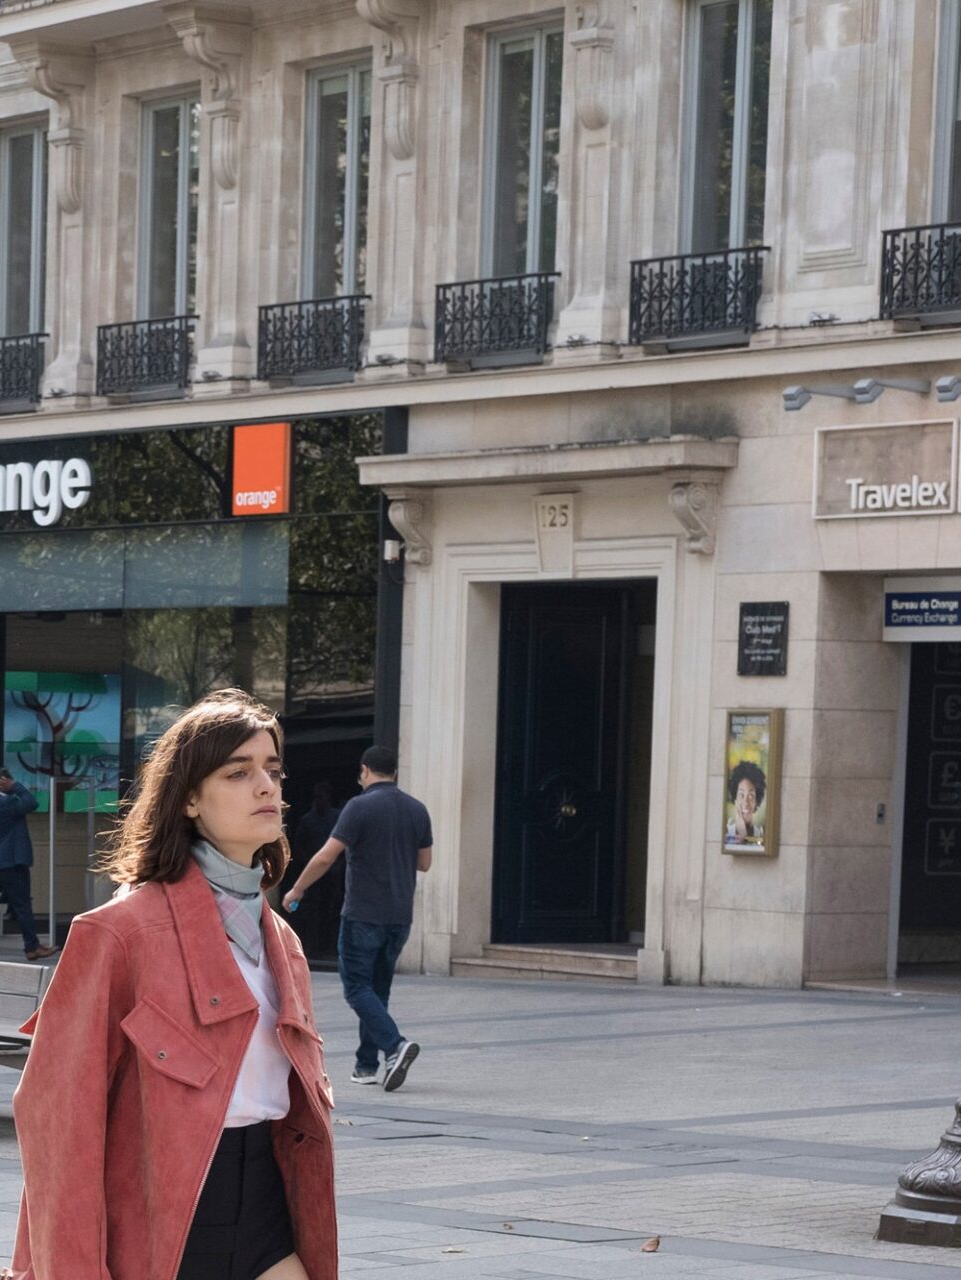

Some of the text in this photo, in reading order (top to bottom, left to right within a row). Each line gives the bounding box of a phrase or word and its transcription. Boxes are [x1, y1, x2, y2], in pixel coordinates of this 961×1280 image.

[235, 490, 277, 509] orange
[845, 474, 948, 510] Travelex
[541, 504, 569, 528] 125
[891, 599, 959, 611] Bureau de Change
[891, 612, 959, 624] Currency Exchange
